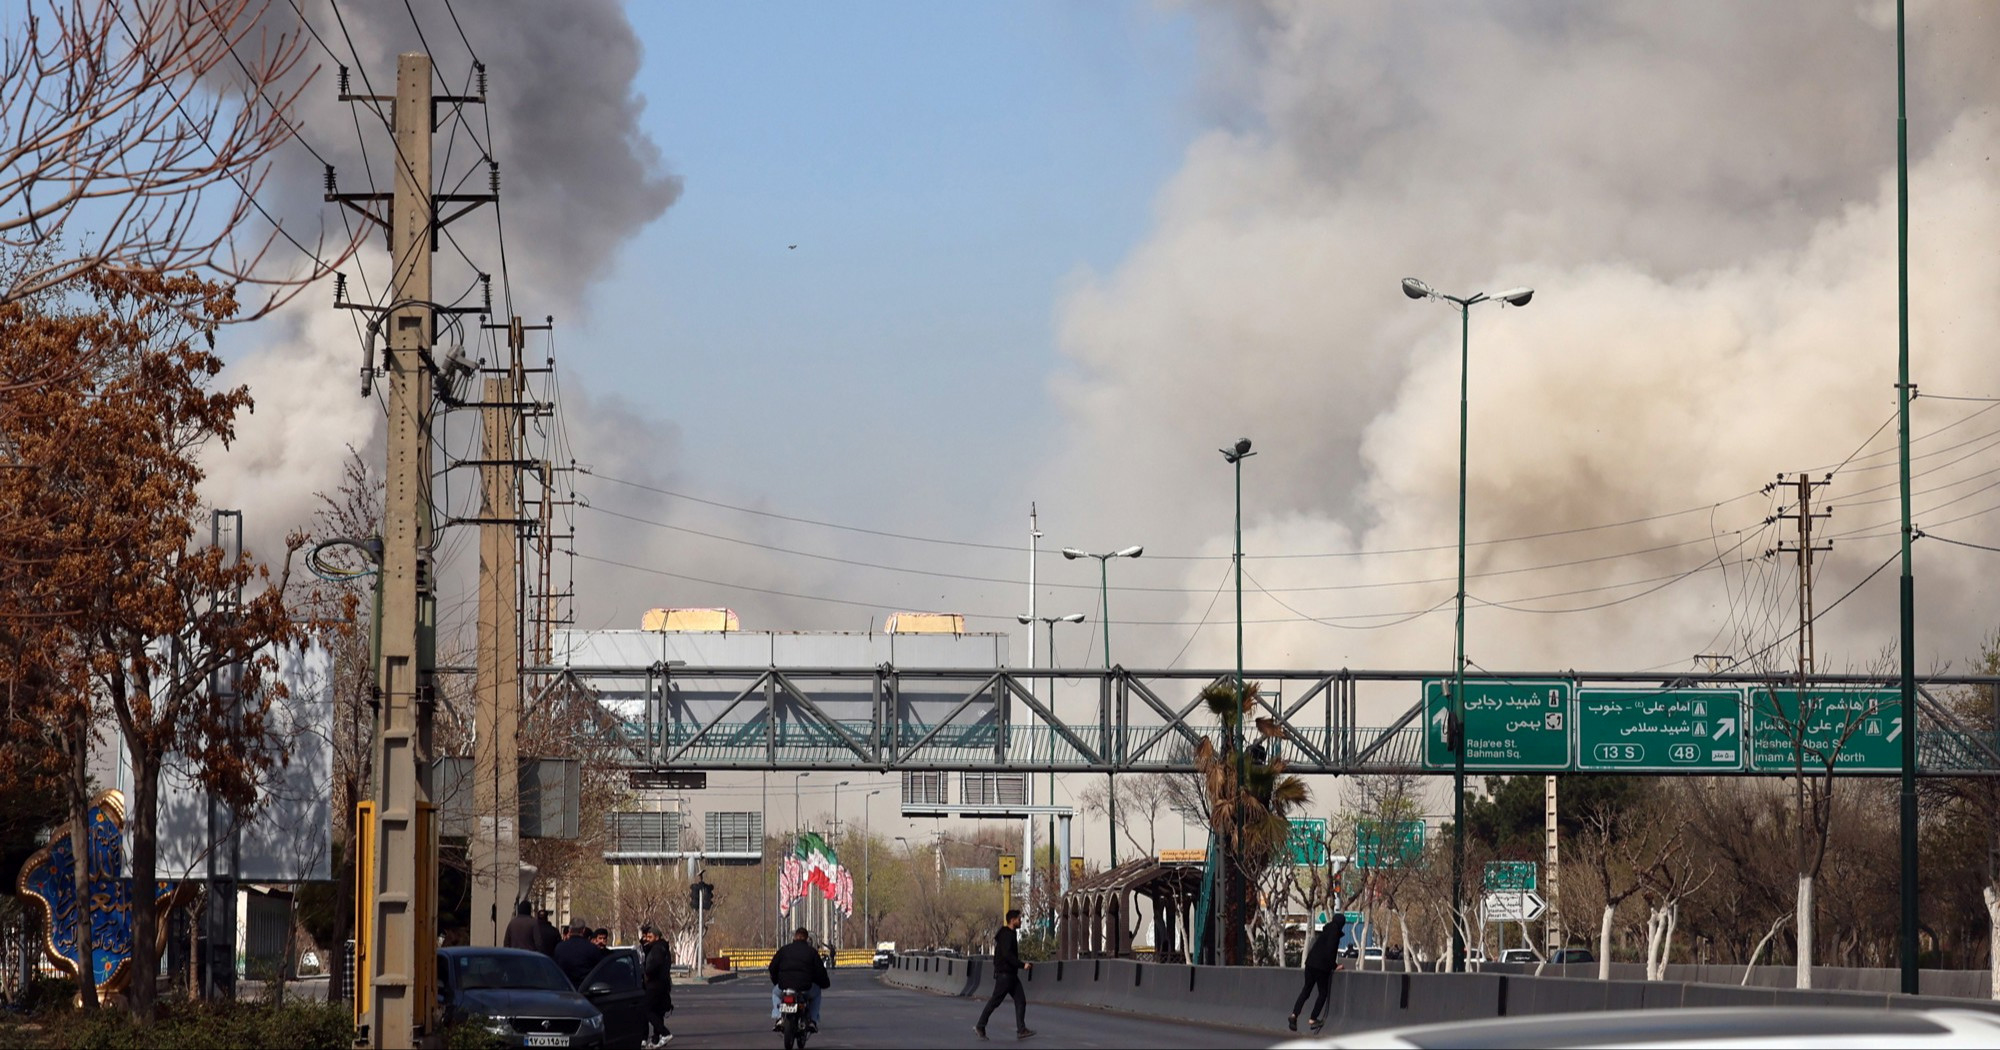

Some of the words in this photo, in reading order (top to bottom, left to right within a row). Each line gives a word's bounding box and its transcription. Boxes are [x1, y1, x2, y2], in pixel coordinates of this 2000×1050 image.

[1464, 694, 1503, 710] رجایی
[1505, 692, 1541, 710] شهید
[1588, 701, 1623, 716] جنوب
[1826, 698, 1862, 716] هاشم
[1668, 701, 1690, 718] امام
[1505, 717, 1541, 732] بهمن
[1620, 722, 1658, 736] سلامی
[1660, 720, 1690, 736] شهید
[1504, 739, 1518, 748] St.
[1466, 749, 1505, 758] Bahman
[1506, 749, 1521, 759] Sq.
[1603, 746, 1618, 759] 13
[1624, 746, 1635, 759] S
[1674, 746, 1695, 759] 48
[1755, 752, 1784, 762] Imam
[1836, 752, 1865, 762] North
